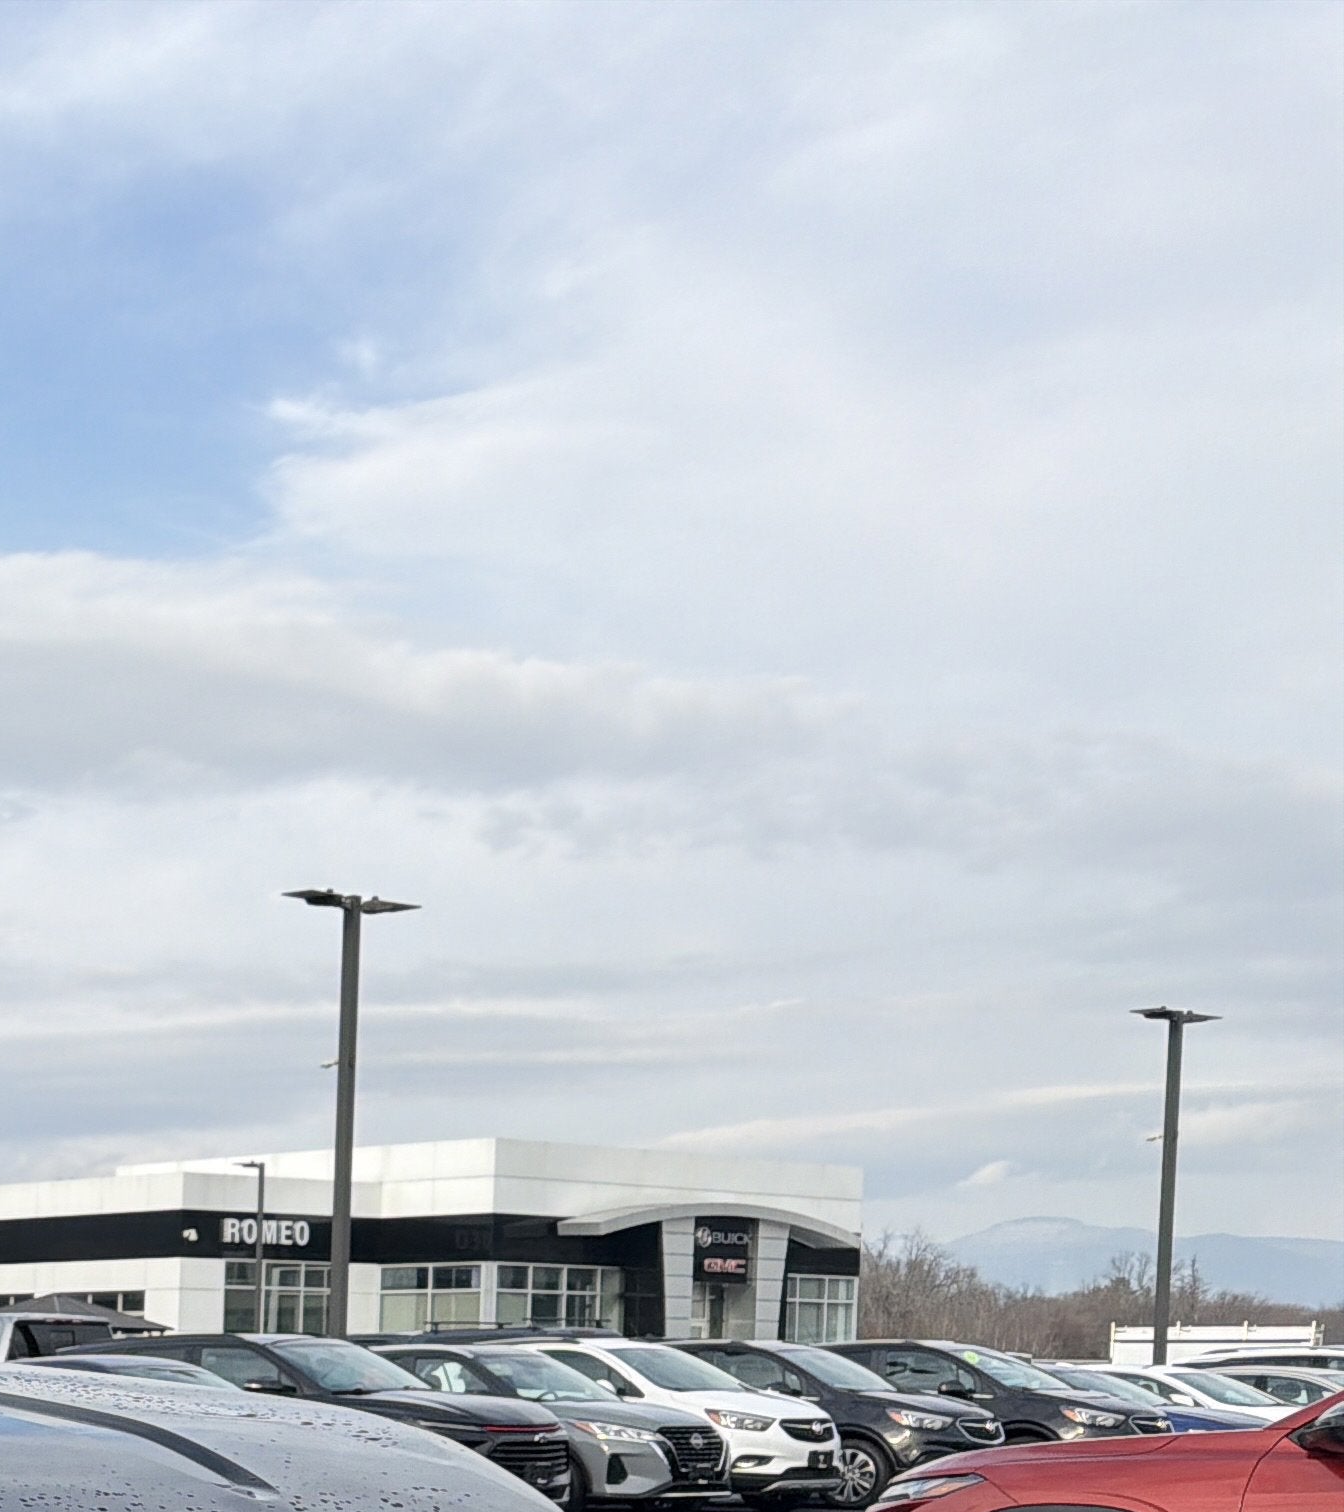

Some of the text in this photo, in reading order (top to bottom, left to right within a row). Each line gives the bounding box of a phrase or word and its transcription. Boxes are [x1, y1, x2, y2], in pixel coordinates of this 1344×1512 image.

[220, 1217, 310, 1247] ROMEO
[712, 1231, 753, 1245] BUICK
[703, 1257, 747, 1275] GMC
